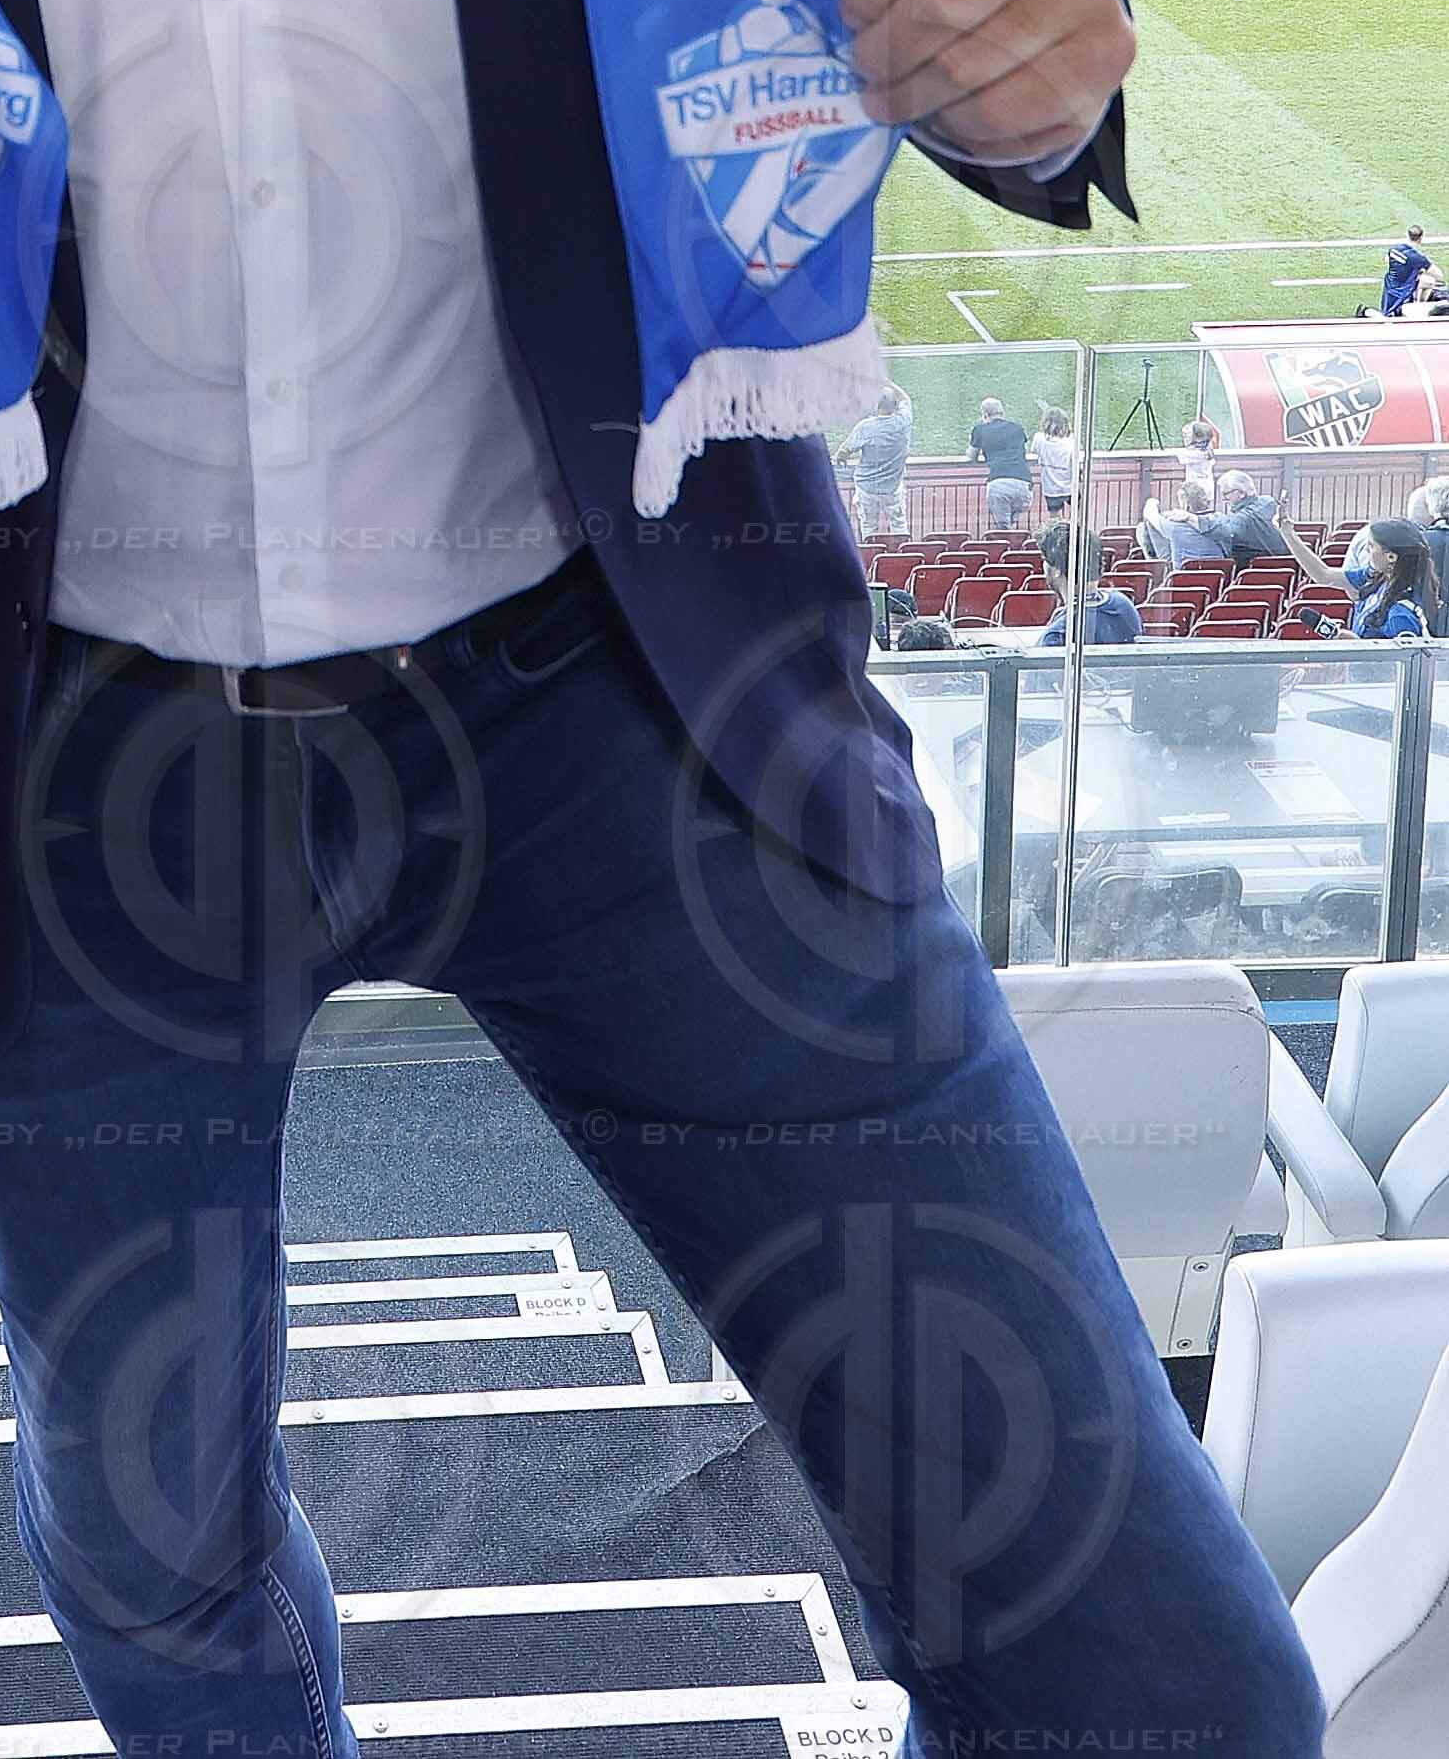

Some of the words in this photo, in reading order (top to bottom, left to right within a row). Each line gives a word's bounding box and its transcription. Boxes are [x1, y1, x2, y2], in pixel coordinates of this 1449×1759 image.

[667, 78, 738, 128] TSV
[748, 64, 862, 108] Hartb
[733, 107, 845, 144] FUSSBALL
[1298, 388, 1370, 428] WAC
[526, 1298, 573, 1309] BLOCK
[577, 1297, 586, 1306] D
[797, 1728, 874, 1747] BLOCK
[878, 1727, 893, 1743] D
